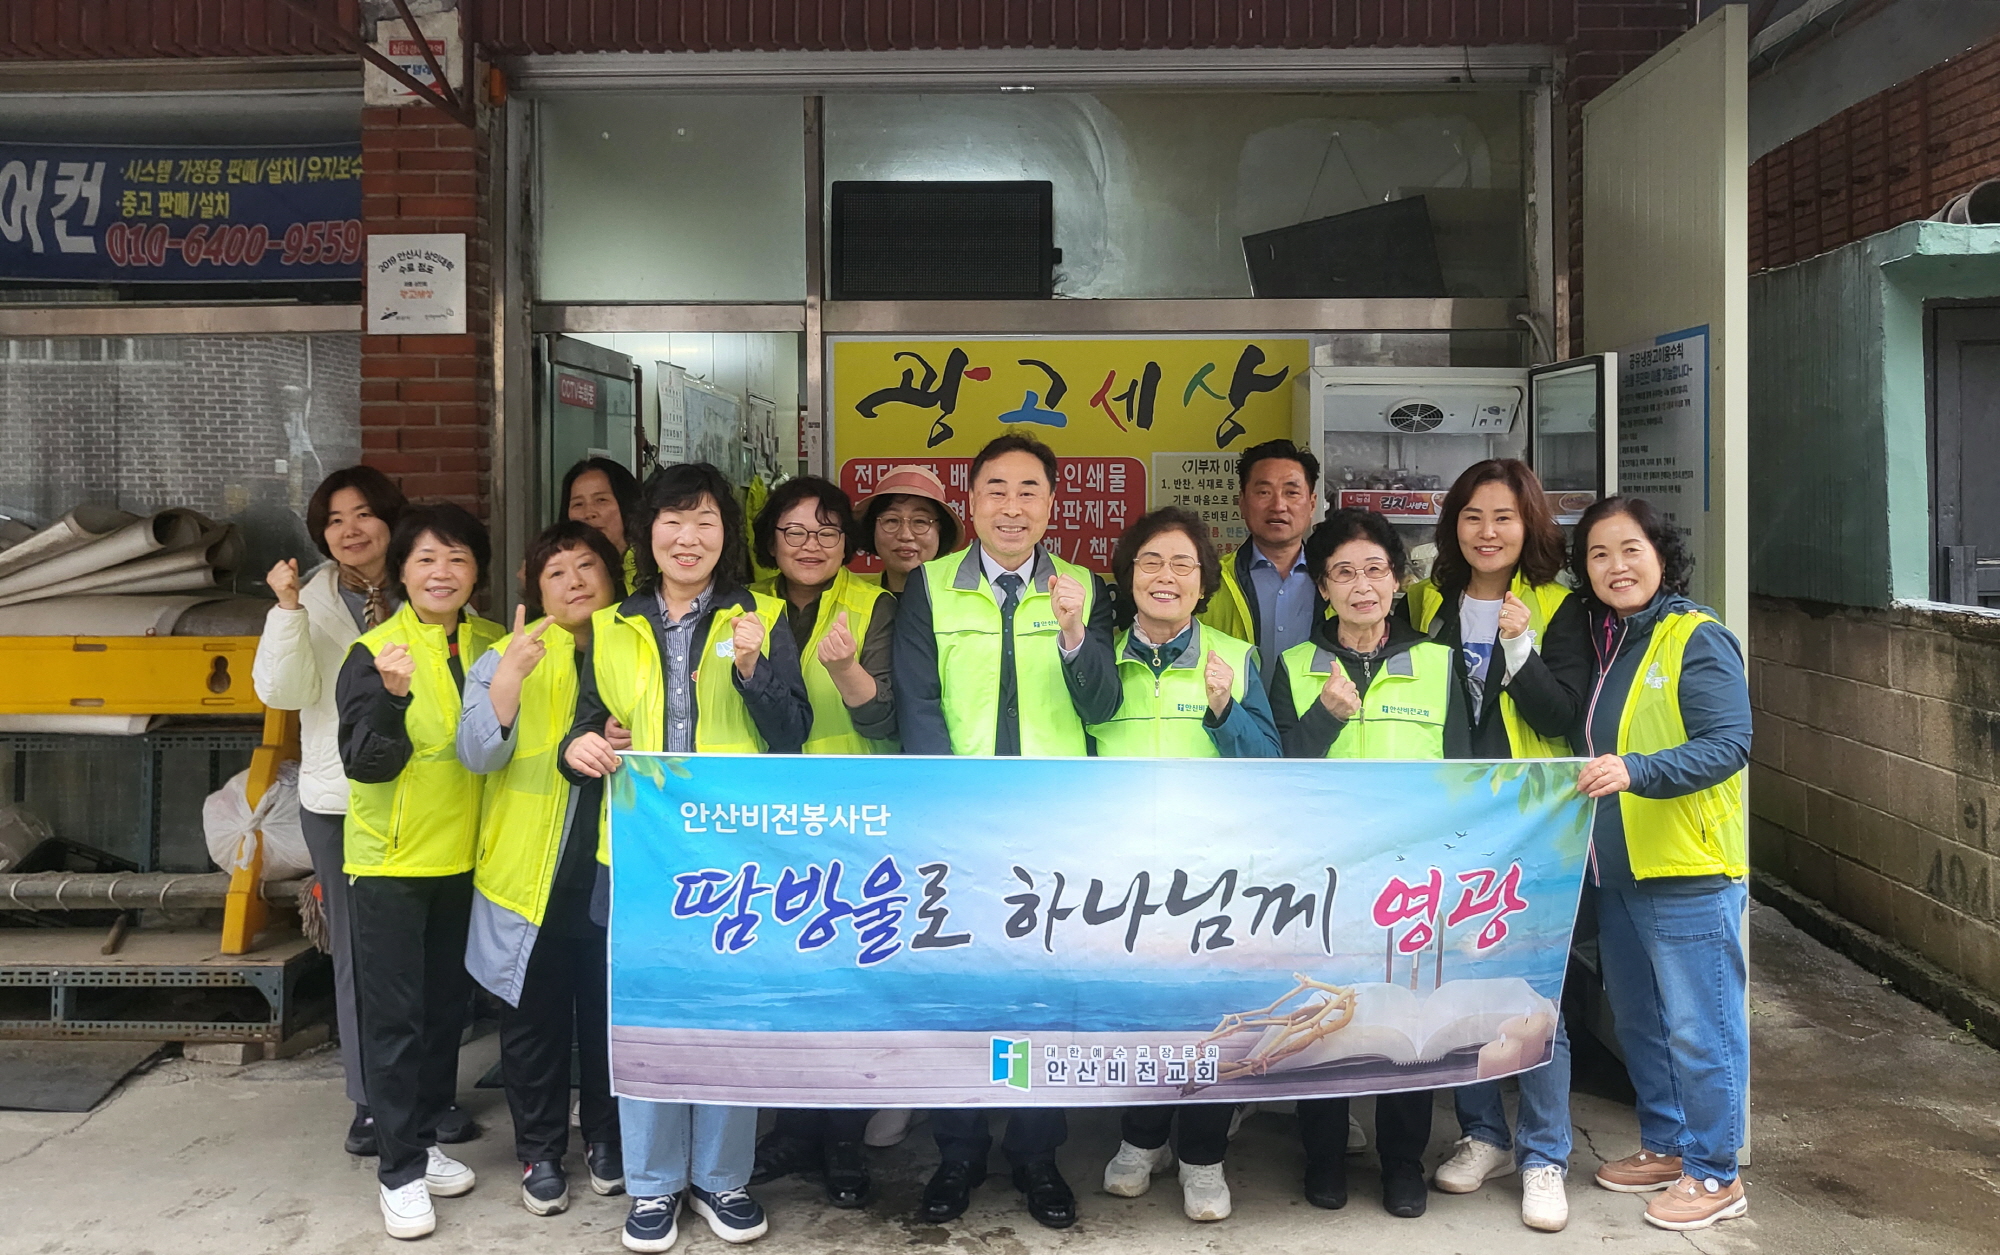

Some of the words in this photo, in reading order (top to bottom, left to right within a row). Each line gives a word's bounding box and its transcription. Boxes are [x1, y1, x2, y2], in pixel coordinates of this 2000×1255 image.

[176, 158, 223, 184] 가정용
[158, 191, 230, 219] 판매/설치
[106, 219, 363, 267] 010-6400-9559
[378, 255, 397, 273] 2019
[396, 249, 422, 262] 안산시
[1629, 341, 1684, 371] 공유냉장고이용수칙
[855, 344, 1290, 449] 광고세상
[1056, 463, 1127, 493] 인쇄물
[1161, 478, 1171, 490] 1.
[1197, 478, 1224, 490] 식재료
[1226, 478, 1235, 490] 등
[1173, 494, 1191, 506] 기쁜
[1193, 494, 1229, 506] 마음으로
[1380, 495, 1409, 511] 김치
[1202, 510, 1228, 522] 준비된
[1184, 704, 1208, 712] 안산비
[1389, 705, 1430, 718] 안산비전교회
[680, 801, 892, 837] 안산비전봉사단
[672, 856, 974, 966] 땀방울로
[1002, 864, 1337, 955] 하나님께
[1371, 862, 1528, 955] 영광
[1047, 1059, 1216, 1084] 안산비전교회
